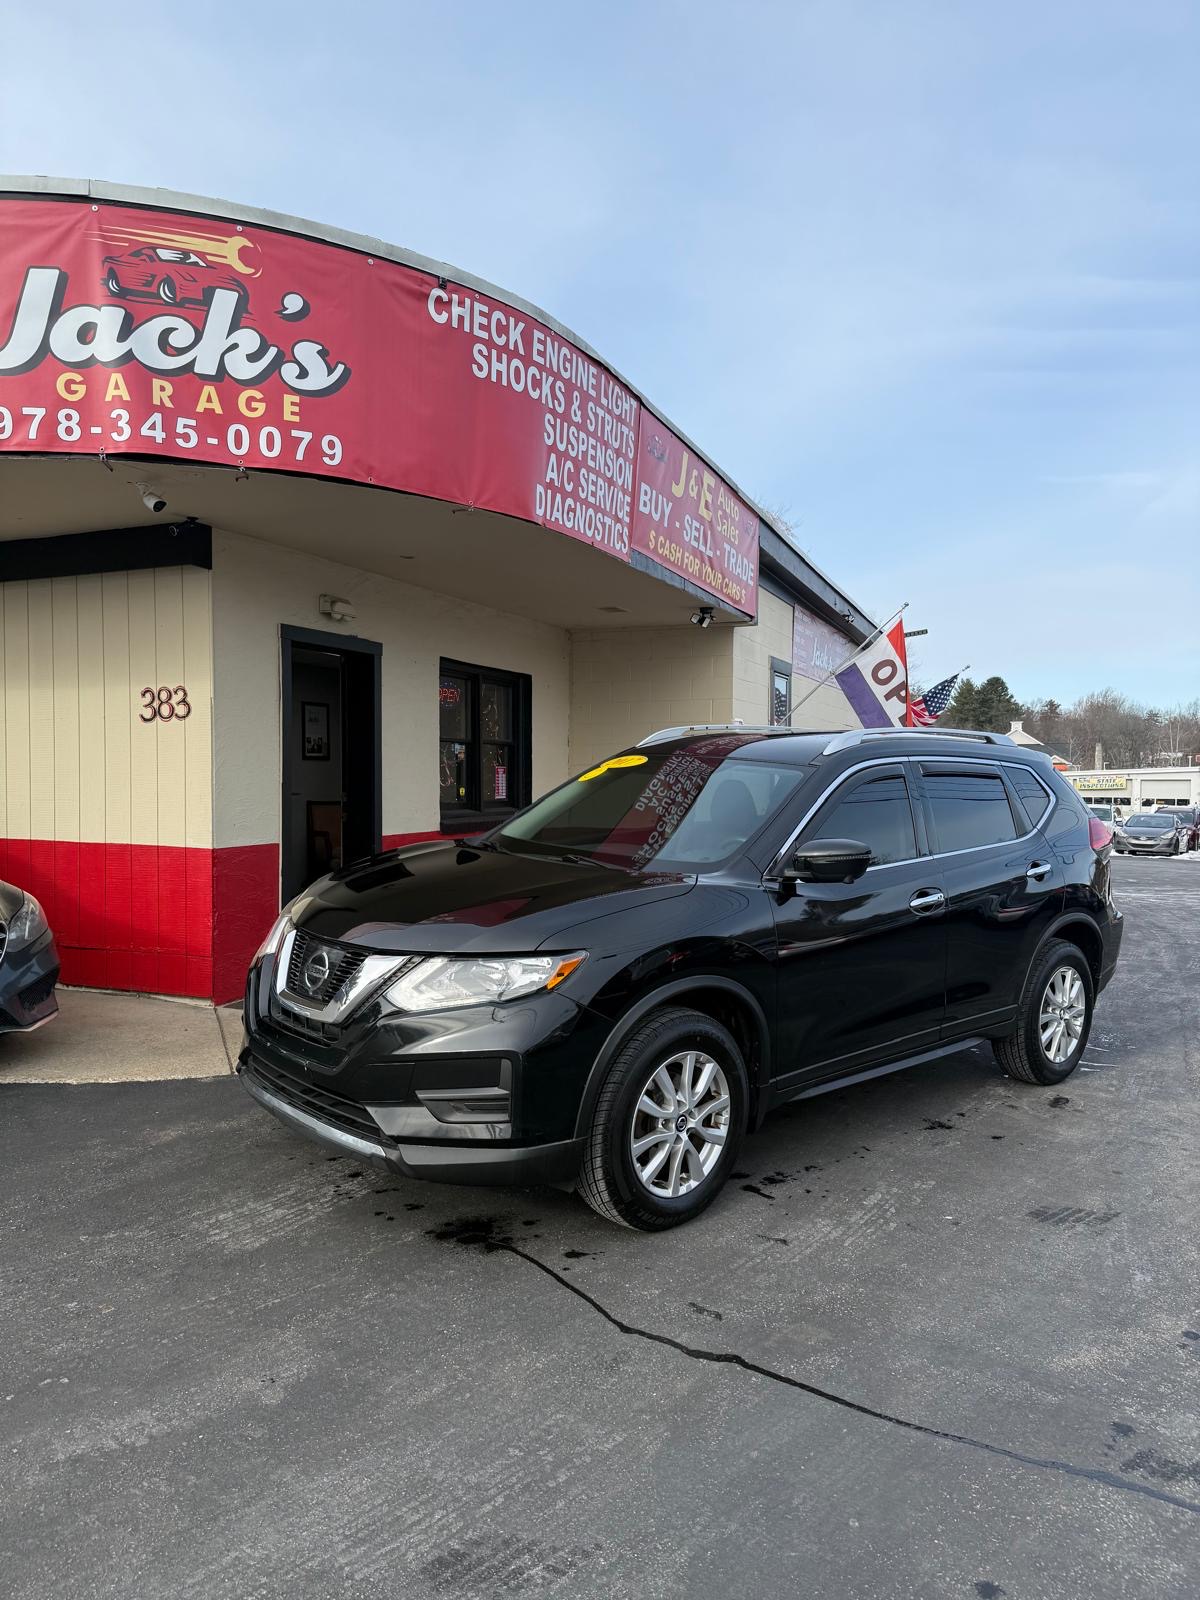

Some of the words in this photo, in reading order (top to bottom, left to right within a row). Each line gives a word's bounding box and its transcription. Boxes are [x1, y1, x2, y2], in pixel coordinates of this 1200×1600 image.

[0, 265, 352, 397] Jack's
[427, 286, 526, 356] CHECK
[532, 328, 598, 398] ENGINE
[600, 372, 638, 427] LIGHT
[55, 371, 301, 423] GARAGE
[471, 342, 566, 414] SHOCKS
[570, 390, 583, 424] &
[587, 401, 635, 459] STRUTS
[0, 405, 344, 467] 978-345-0079
[543, 412, 634, 492] SUSPENSION
[535, 483, 629, 554] DIAGNOSTICS
[545, 452, 575, 492] A/C
[578, 467, 632, 524] SERVICE
[671, 450, 689, 499] J
[688, 468, 699, 500] &
[698, 469, 716, 522] E
[717, 485, 740, 522] Auto
[638, 481, 673, 529] BUY
[683, 513, 714, 558] SELL
[723, 542, 755, 587] TRADE
[716, 509, 740, 546] Sales
[657, 535, 683, 567] CASH
[683, 551, 701, 579] FOR
[701, 563, 723, 590] YOUR
[722, 576, 741, 601] CARS
[139, 685, 192, 722] 383
[871, 659, 908, 728] OP
